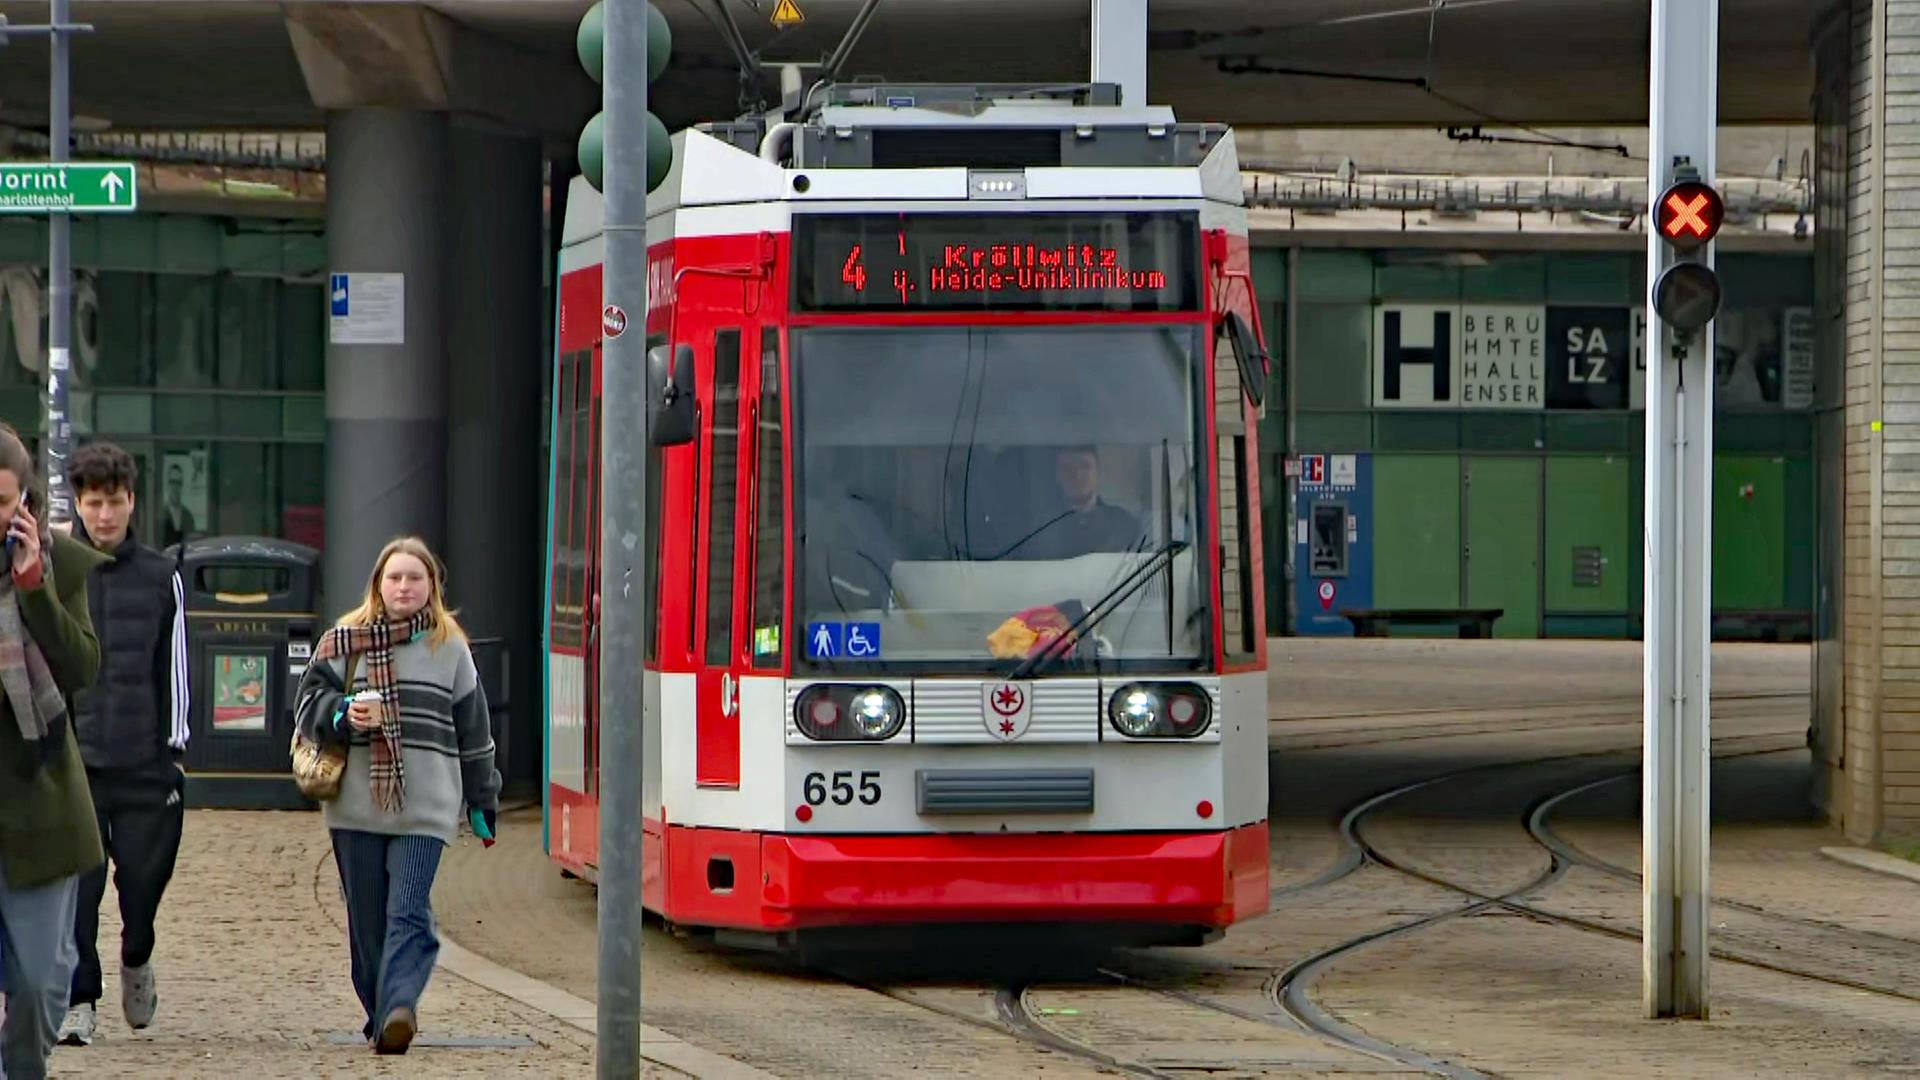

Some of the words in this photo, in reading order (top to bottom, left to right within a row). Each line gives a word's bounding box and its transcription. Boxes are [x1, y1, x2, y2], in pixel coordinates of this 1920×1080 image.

[0, 169, 67, 190] orint
[842, 245, 866, 290] 4
[945, 244, 1116, 269] Kröllwitz
[931, 267, 1166, 290] Heide-Uniklinikum
[1465, 339, 1540, 356] HMTE
[1567, 326, 1608, 354] SA
[1384, 311, 1450, 400] H
[1465, 362, 1540, 380] HALL
[1568, 358, 1608, 383] LZ
[1464, 384, 1538, 401] ENSER
[803, 770, 882, 806] 655
